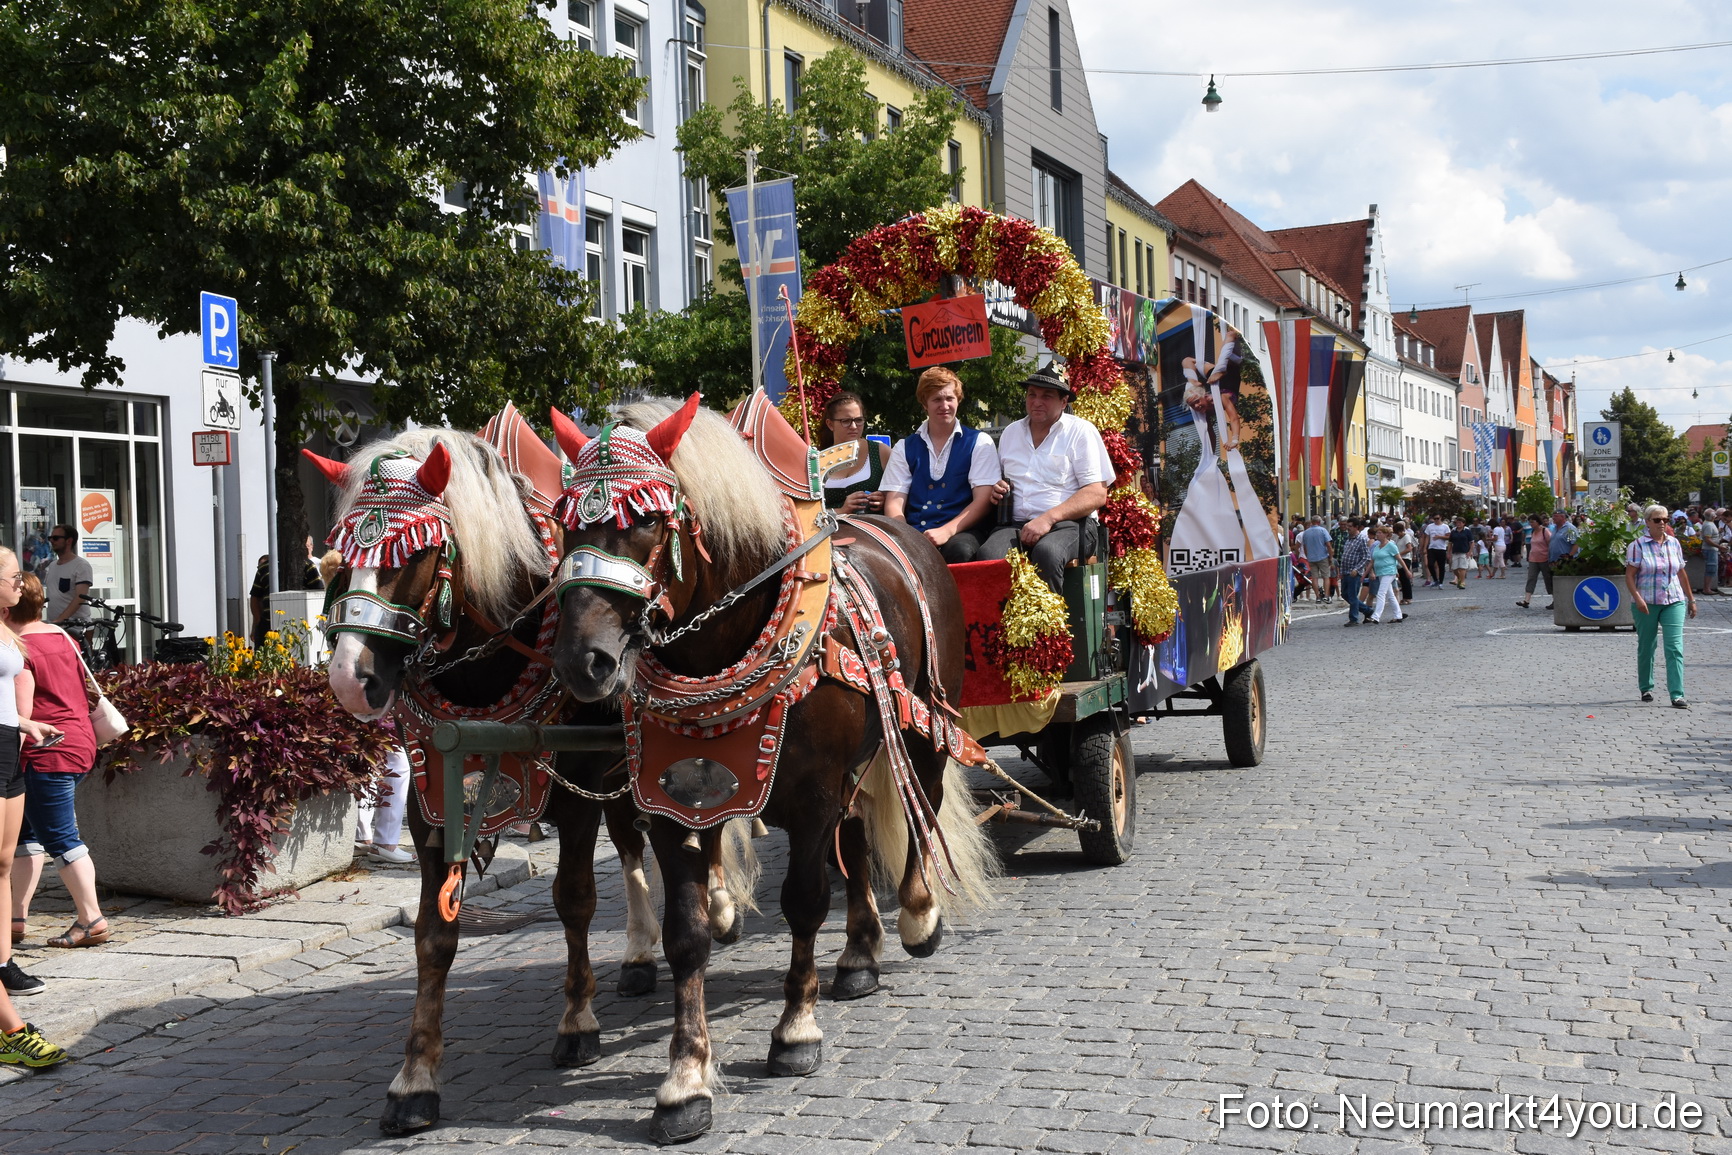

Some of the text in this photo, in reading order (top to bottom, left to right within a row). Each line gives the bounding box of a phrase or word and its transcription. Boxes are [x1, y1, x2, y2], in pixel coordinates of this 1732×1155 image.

[210, 303, 230, 357] P
[909, 315, 984, 358] Circusverein
[925, 349, 953, 358] Neumarkt
[215, 378, 229, 389] nur
[200, 434, 220, 443] H150
